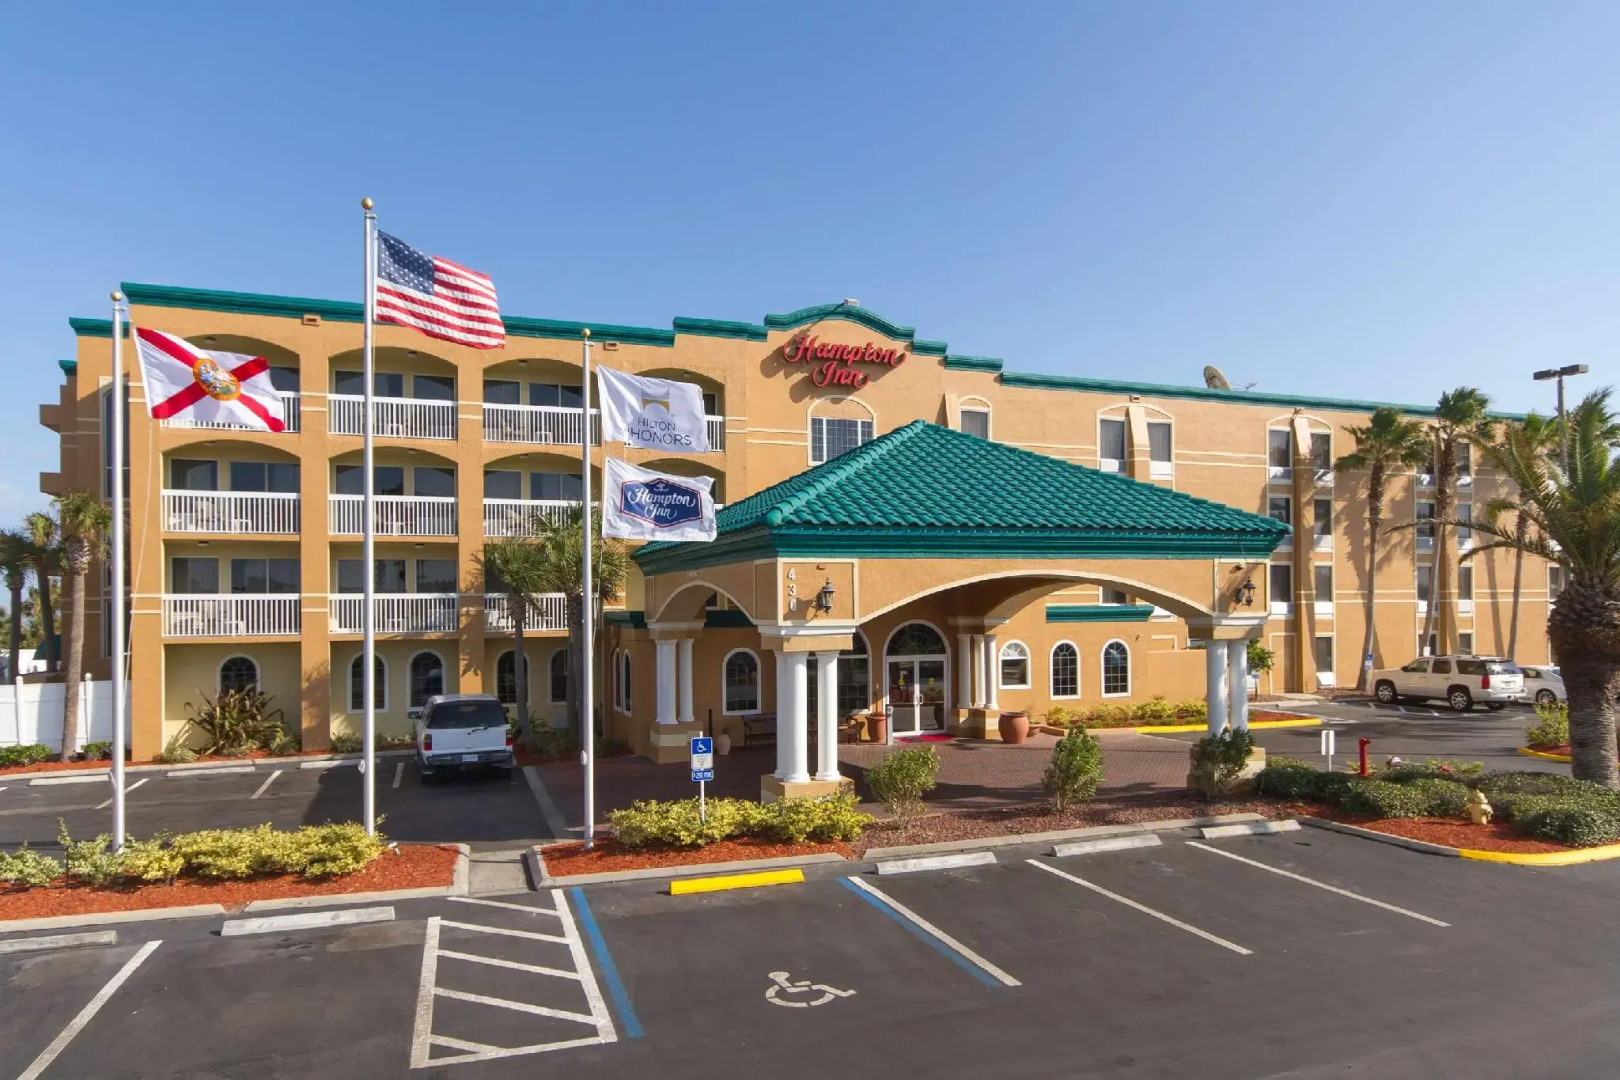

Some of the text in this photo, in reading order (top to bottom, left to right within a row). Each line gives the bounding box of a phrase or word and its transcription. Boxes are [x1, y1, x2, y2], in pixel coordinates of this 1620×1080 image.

[783, 334, 907, 368] Hampton
[812, 360, 871, 389] Inn
[637, 417, 676, 431] HILTON
[627, 488, 696, 507] Hampton
[644, 503, 677, 519] Inn
